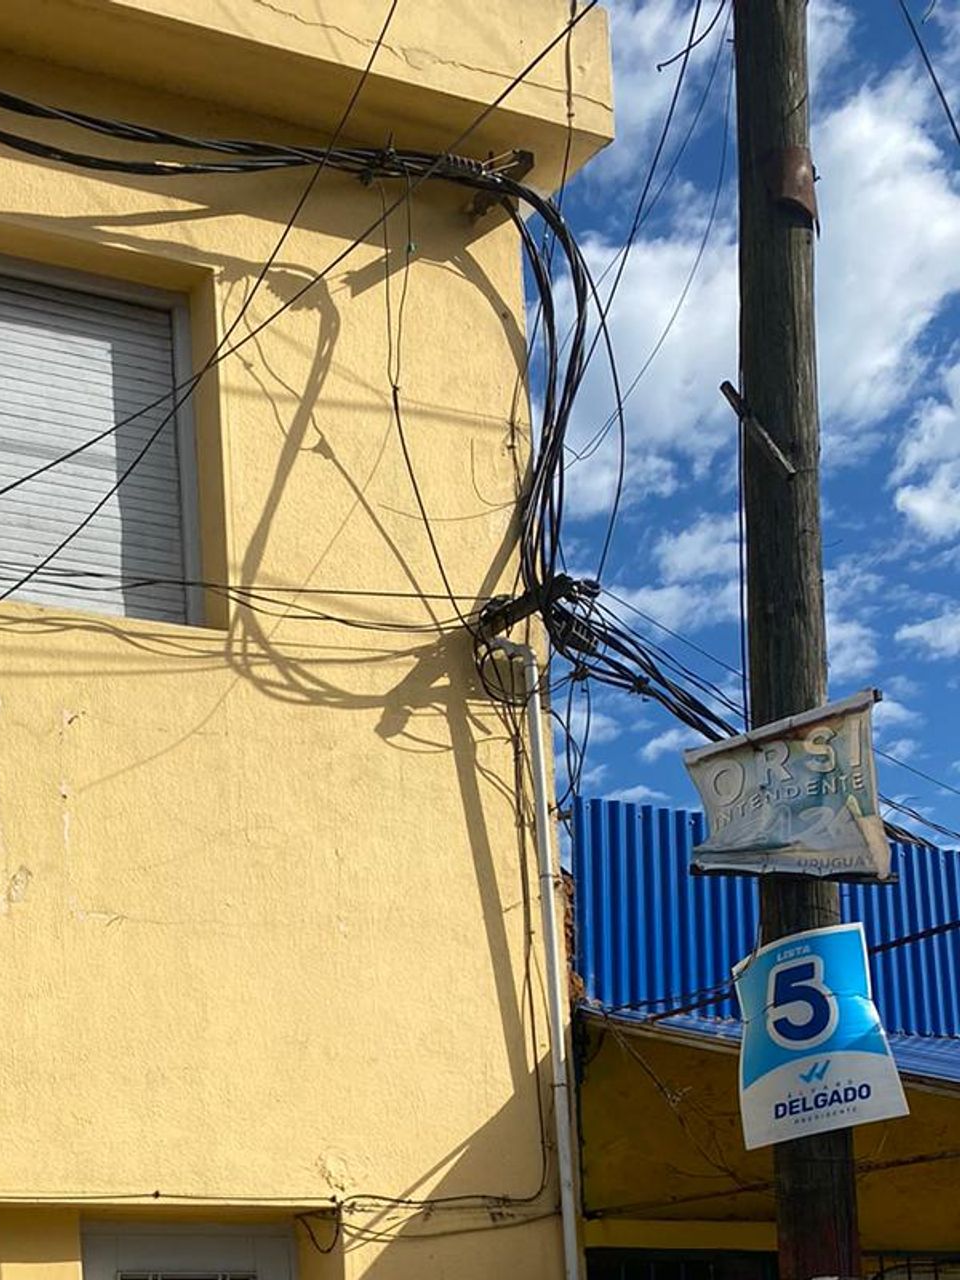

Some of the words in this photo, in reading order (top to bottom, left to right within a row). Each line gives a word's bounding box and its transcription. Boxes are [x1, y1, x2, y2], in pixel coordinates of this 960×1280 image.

[712, 715, 862, 807] ORSI
[770, 959, 834, 1045] 5
[774, 1083, 871, 1120] DELGADO
